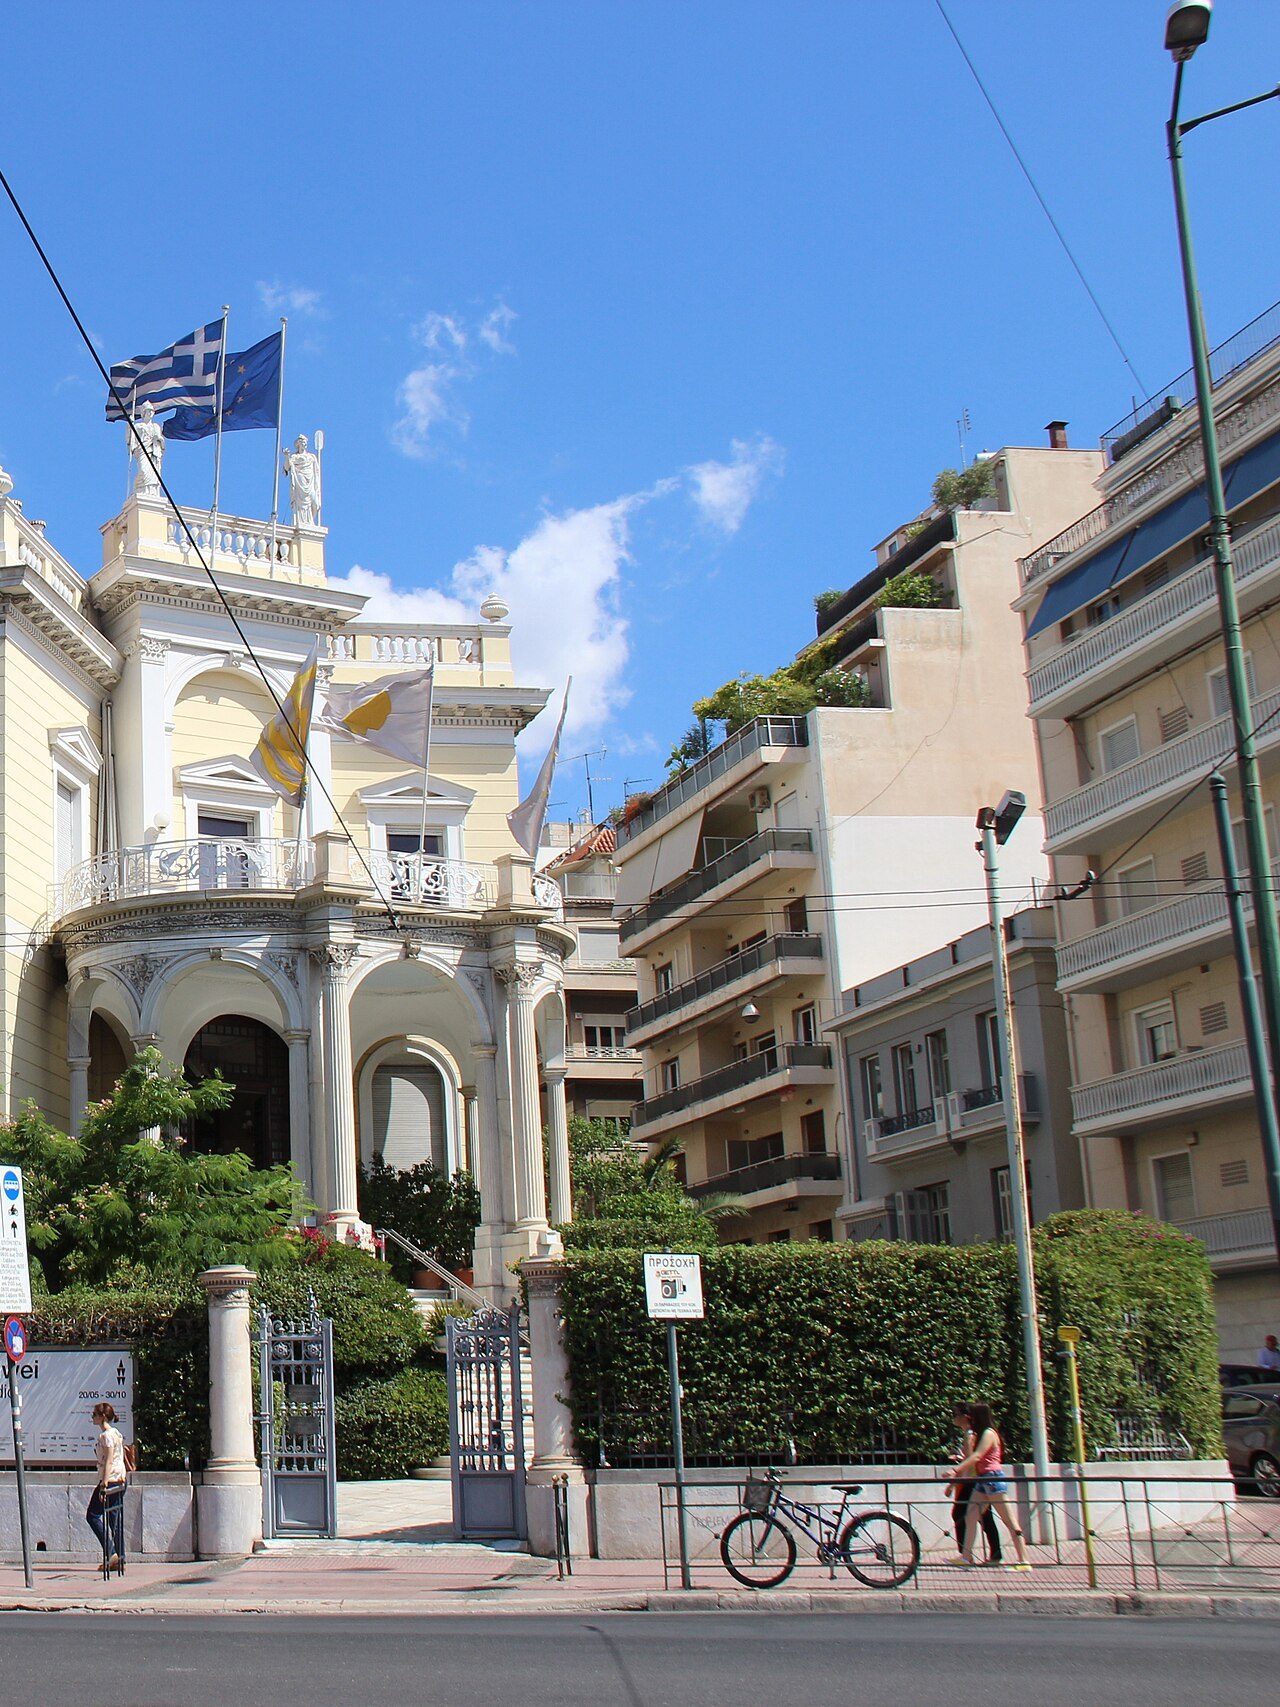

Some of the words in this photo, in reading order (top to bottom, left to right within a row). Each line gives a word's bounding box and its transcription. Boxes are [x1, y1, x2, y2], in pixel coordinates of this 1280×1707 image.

[649, 1258, 695, 1267] ΠΡΟΣΟΧΗ
[78, 1390, 99, 1399] 20/05
[106, 1390, 126, 1399] 30/10
